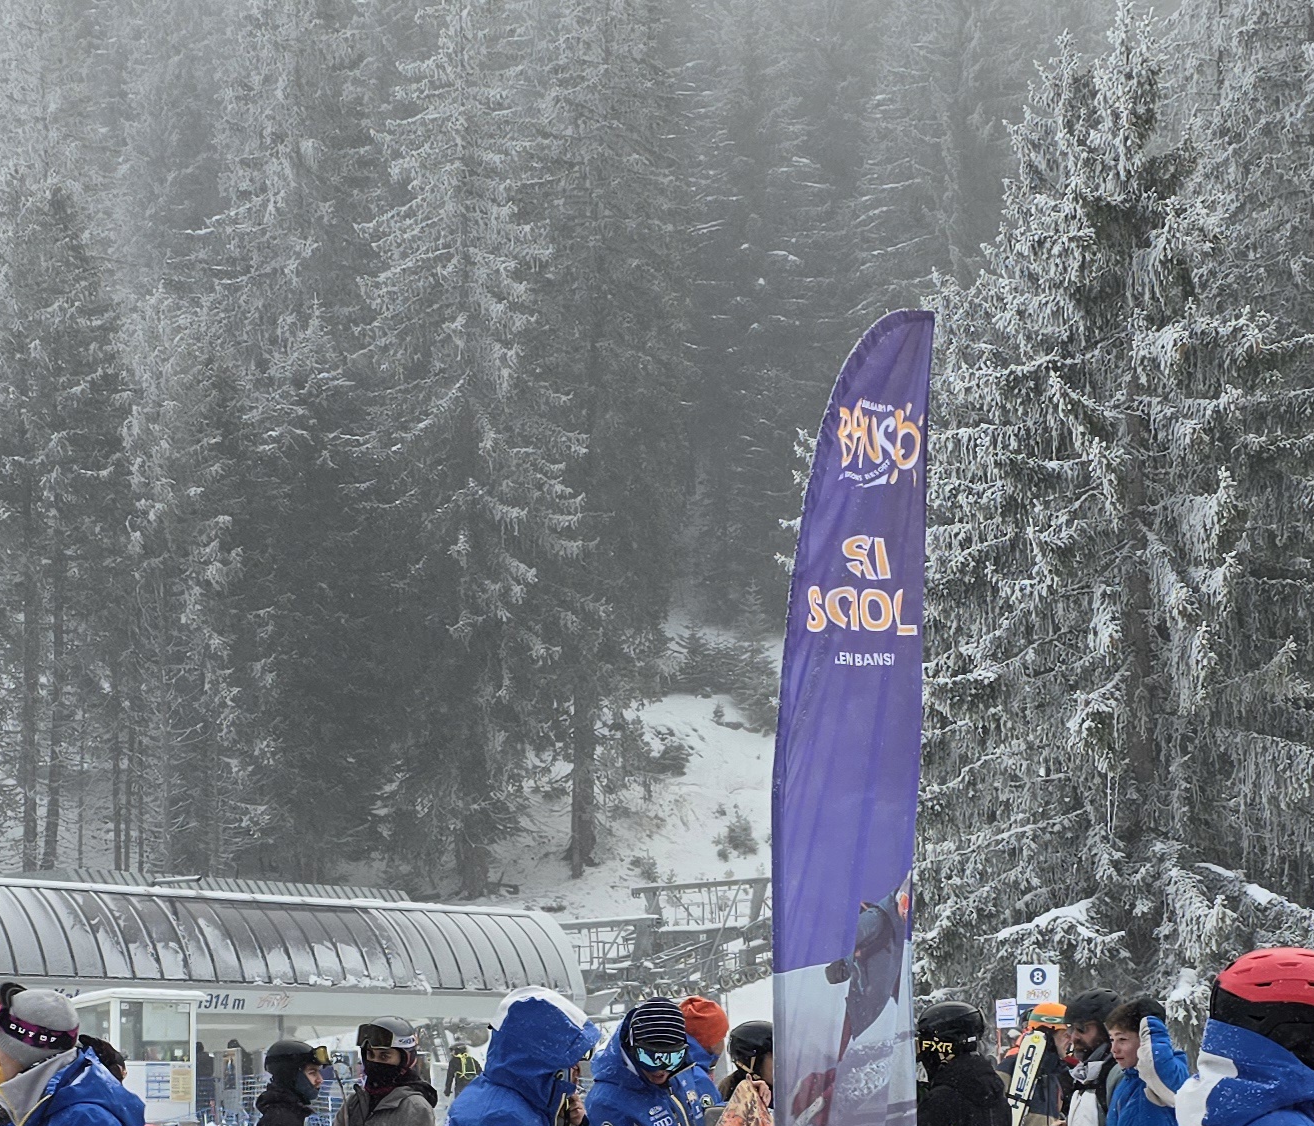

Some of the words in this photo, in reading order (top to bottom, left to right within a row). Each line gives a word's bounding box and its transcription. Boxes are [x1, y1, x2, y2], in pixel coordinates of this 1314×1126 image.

[1033, 970, 1044, 986] 8
[232, 998, 246, 1011] m
[921, 1040, 953, 1053] FXR
